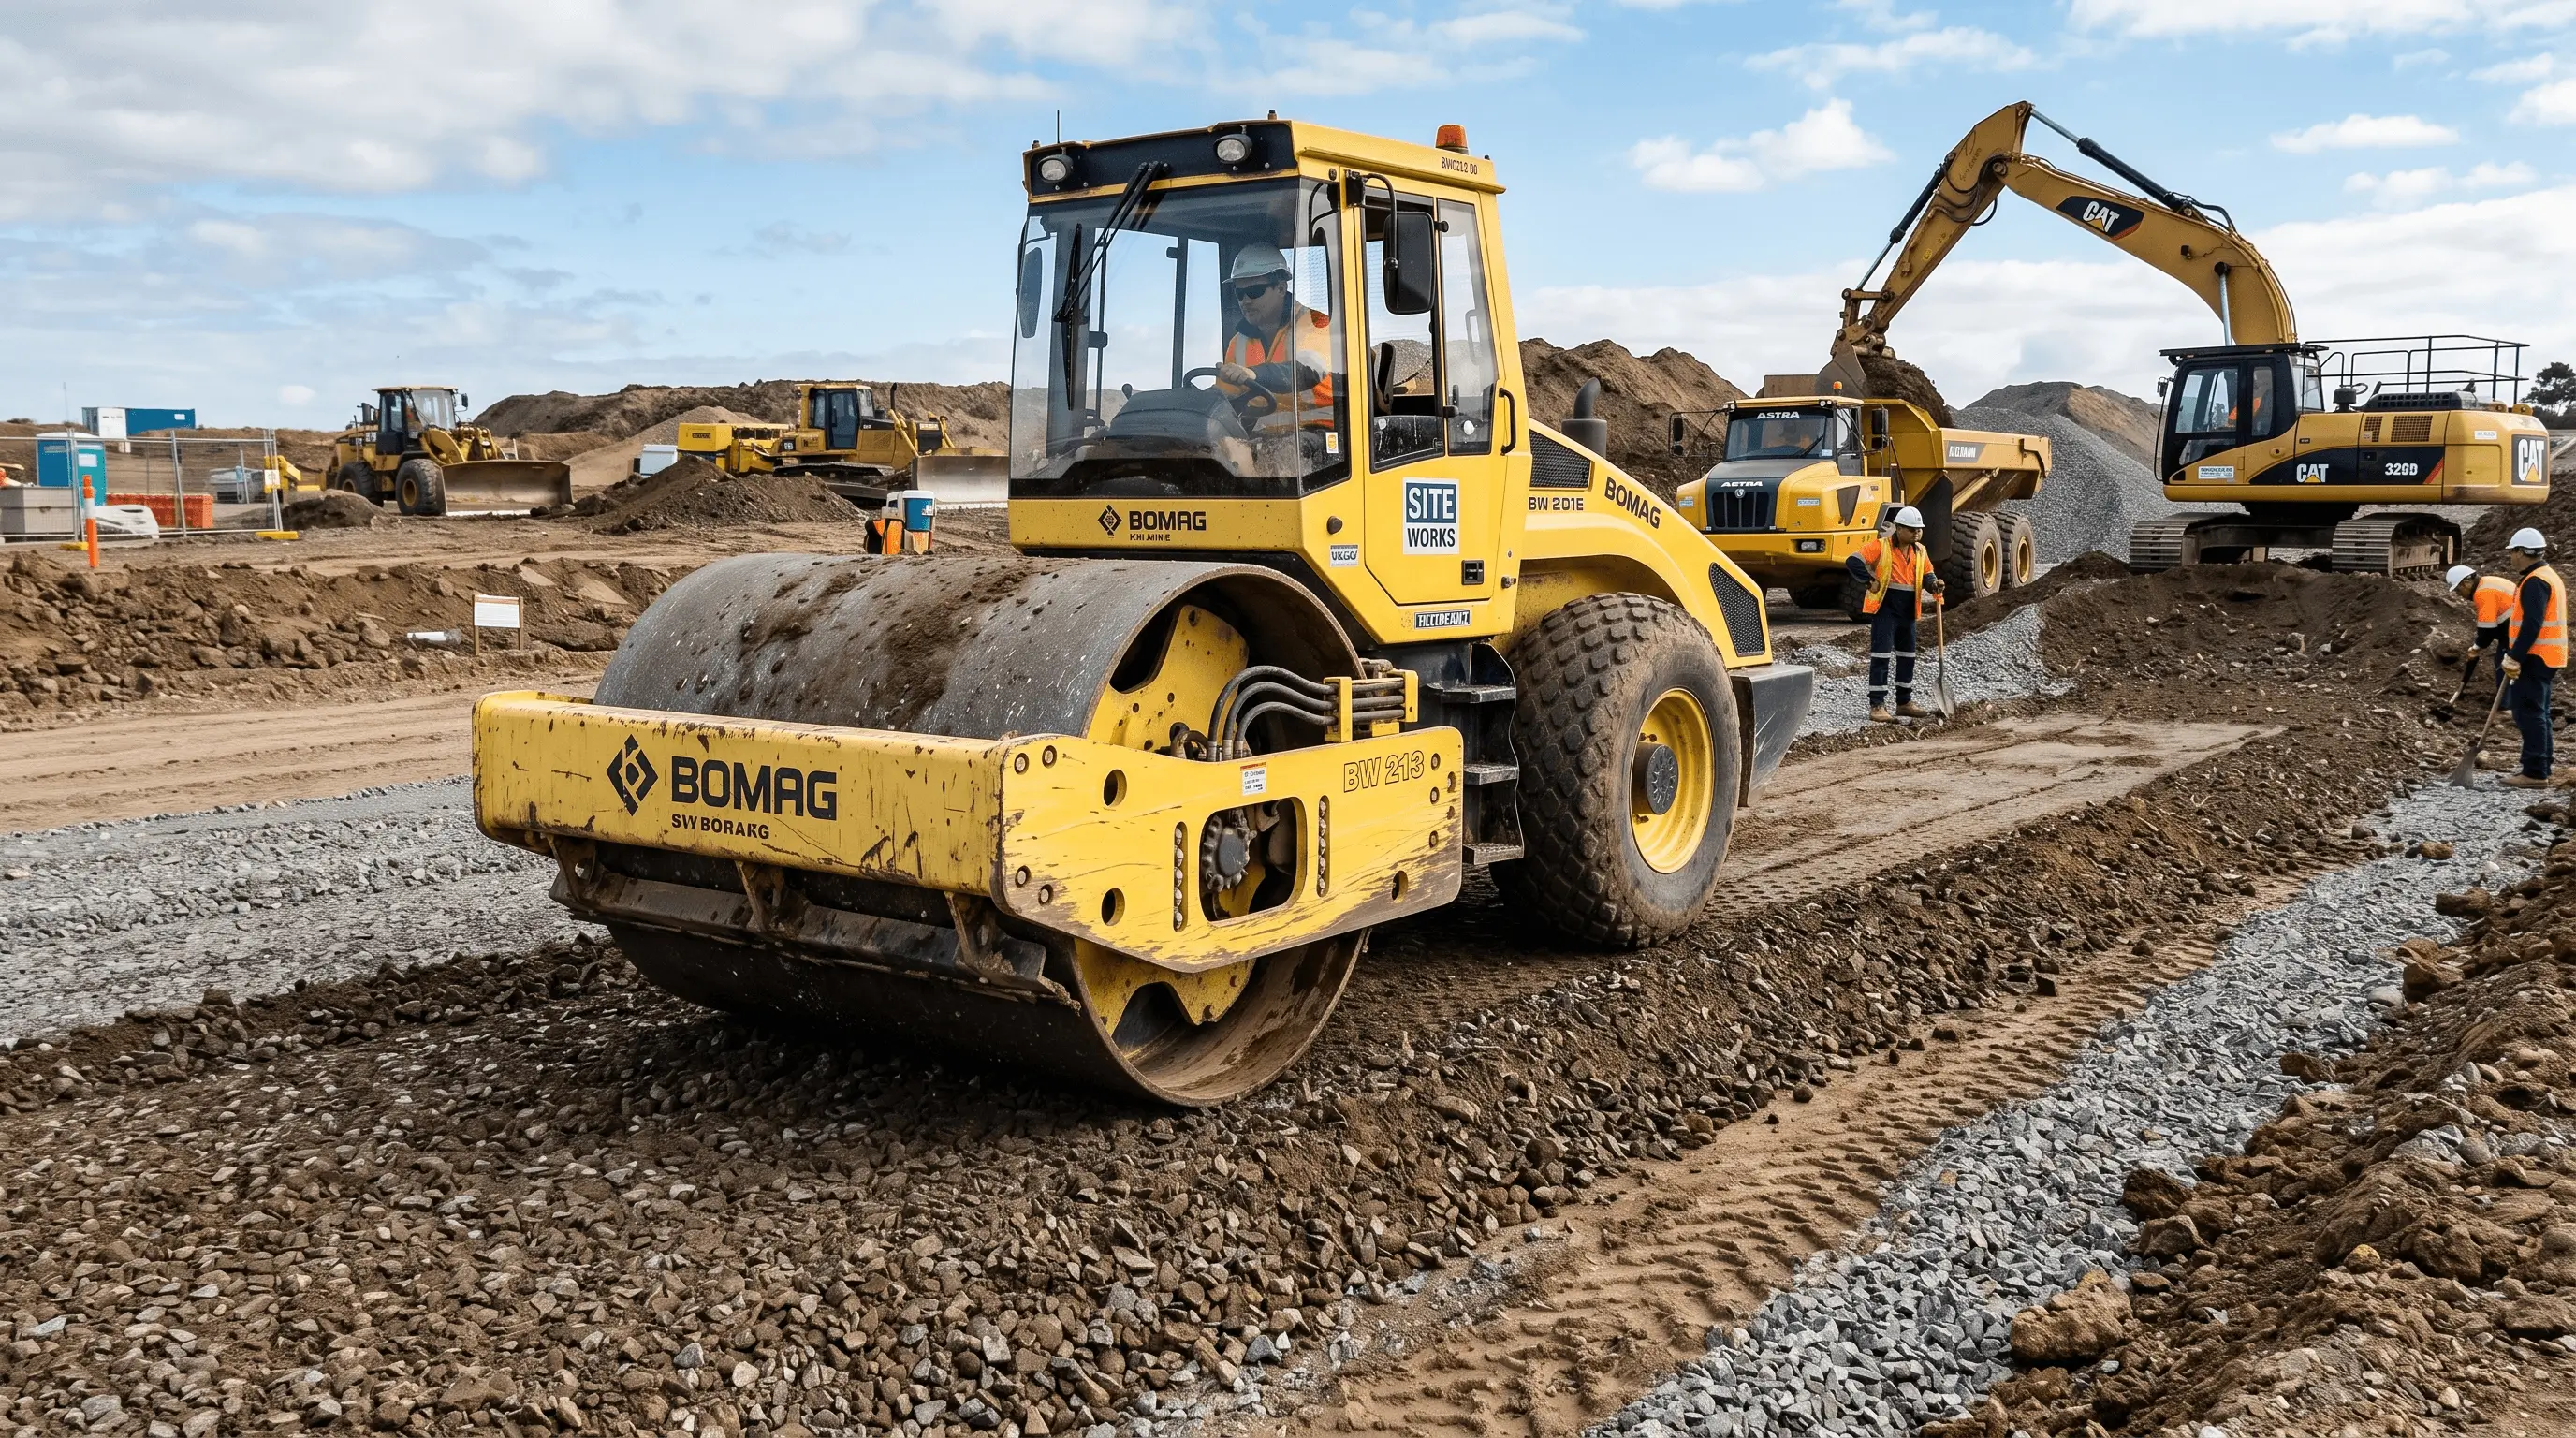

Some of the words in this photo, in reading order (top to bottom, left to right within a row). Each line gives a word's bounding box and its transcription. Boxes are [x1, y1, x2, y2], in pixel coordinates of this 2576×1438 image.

[2082, 200, 2120, 233] CAT
[1756, 411, 1800, 419] ASTRA
[2296, 463, 2329, 483] CAT
[2518, 438, 2545, 482] CAT
[1408, 487, 1455, 520] SITE
[1529, 496, 1548, 511] BW
[1552, 497, 1584, 511] 201E
[1604, 476, 1661, 529] BOMAG
[1129, 510, 1207, 531] BOMAG
[1407, 527, 1456, 548] WORKS
[1343, 756, 1382, 793] BW
[1384, 750, 1425, 785] 213
[671, 756, 838, 821] BOMAG
